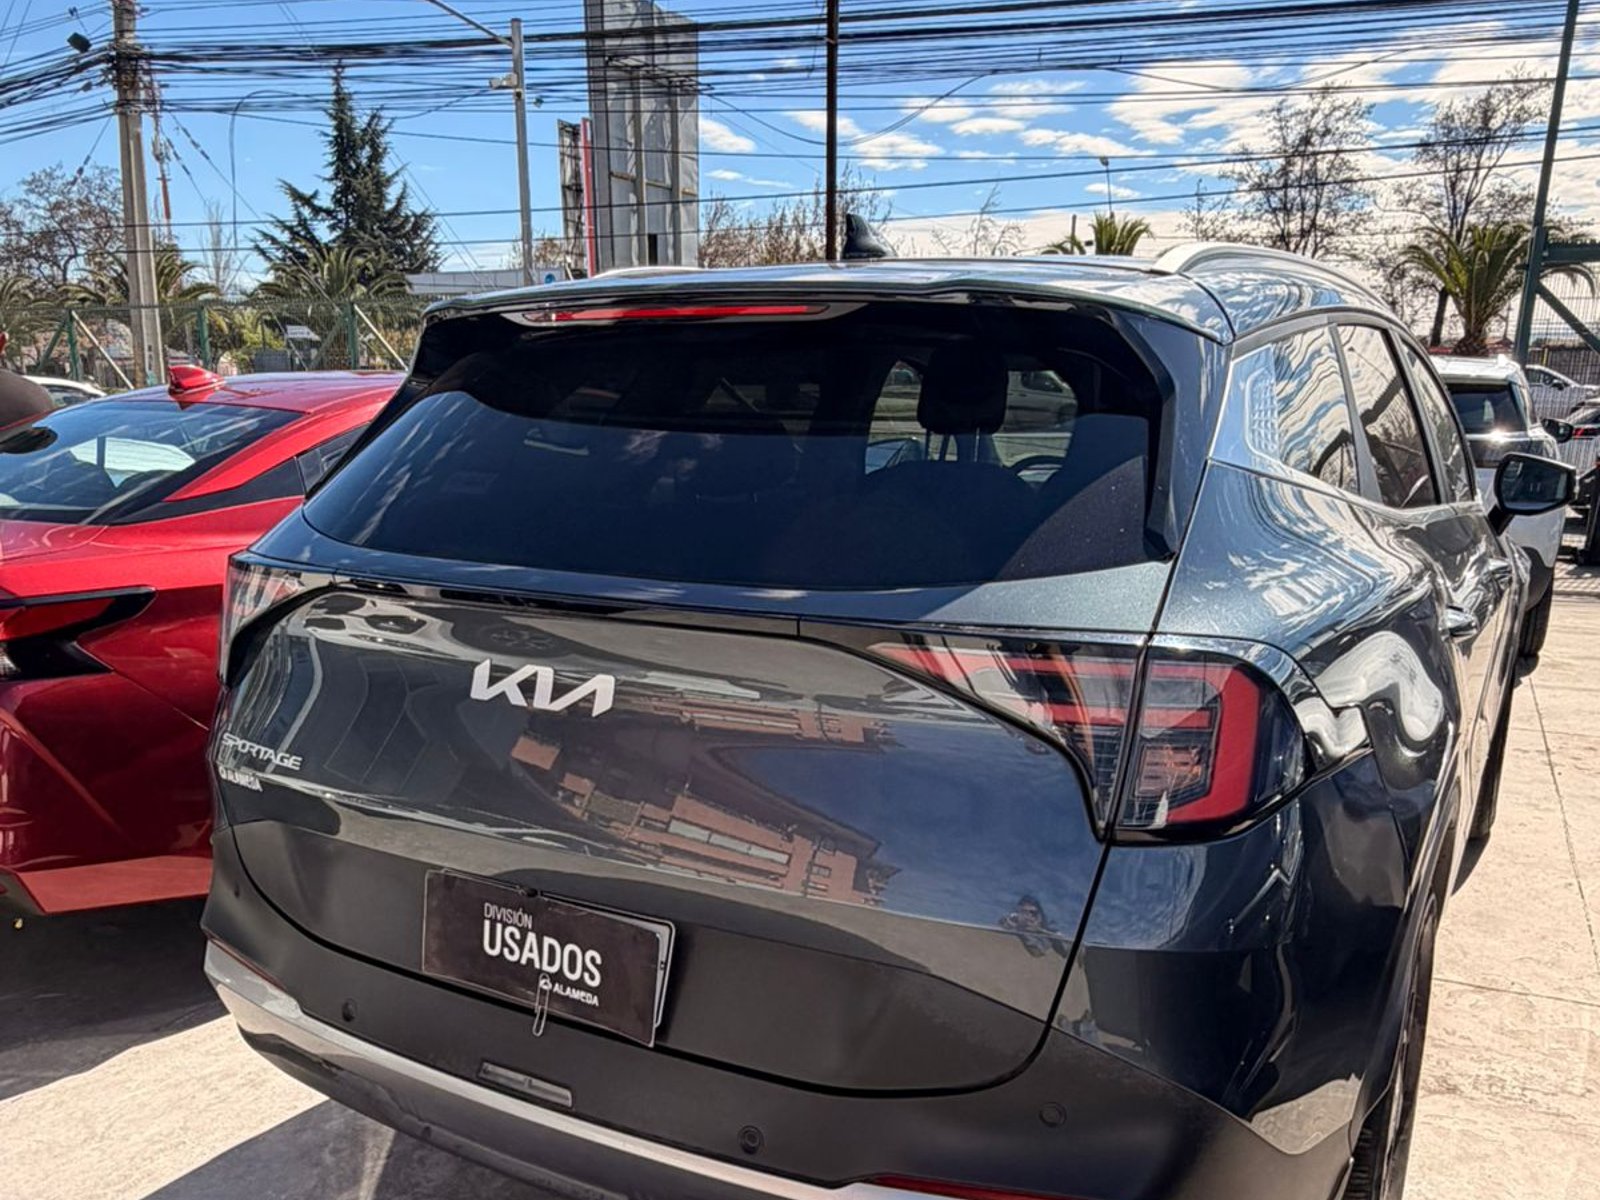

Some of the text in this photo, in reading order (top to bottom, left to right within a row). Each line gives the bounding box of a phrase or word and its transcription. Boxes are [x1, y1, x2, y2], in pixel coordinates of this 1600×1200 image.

[470, 658, 615, 717] KIA
[222, 732, 303, 770] SPORTAGE
[484, 902, 532, 929] DIVISIÓN
[483, 919, 602, 987] USADOS
[552, 982, 599, 1006] ALAMEDA
